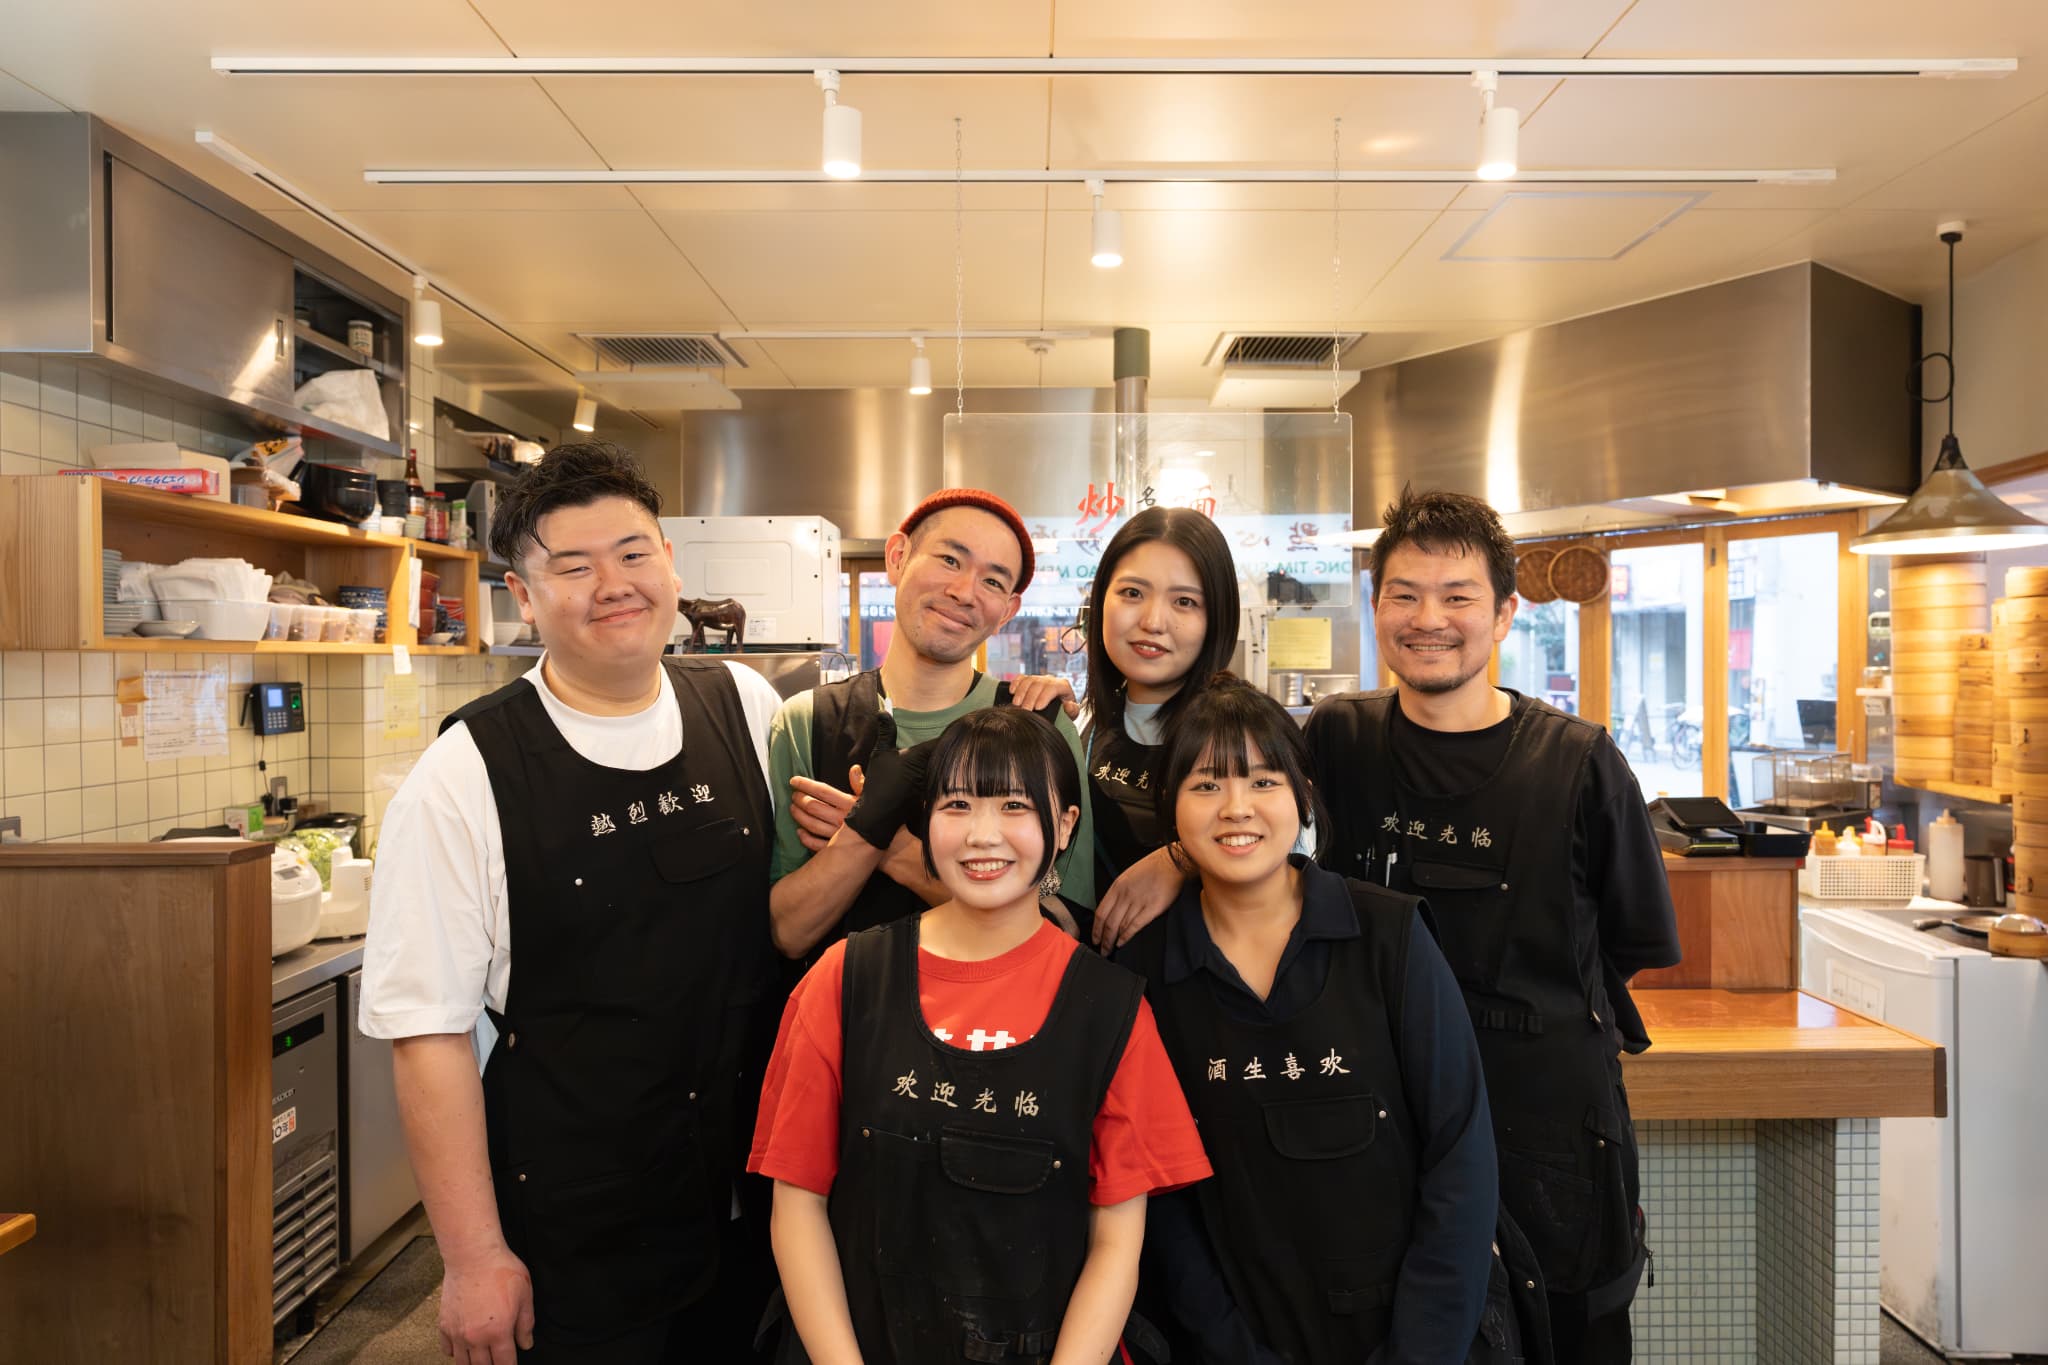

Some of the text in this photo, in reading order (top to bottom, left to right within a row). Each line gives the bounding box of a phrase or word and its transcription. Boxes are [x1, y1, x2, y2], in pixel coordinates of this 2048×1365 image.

[1380, 811, 1493, 849] 欢迎光临
[1207, 1048, 1352, 1081] 酒生喜欢
[891, 1069, 1040, 1117] 欢迎光临
